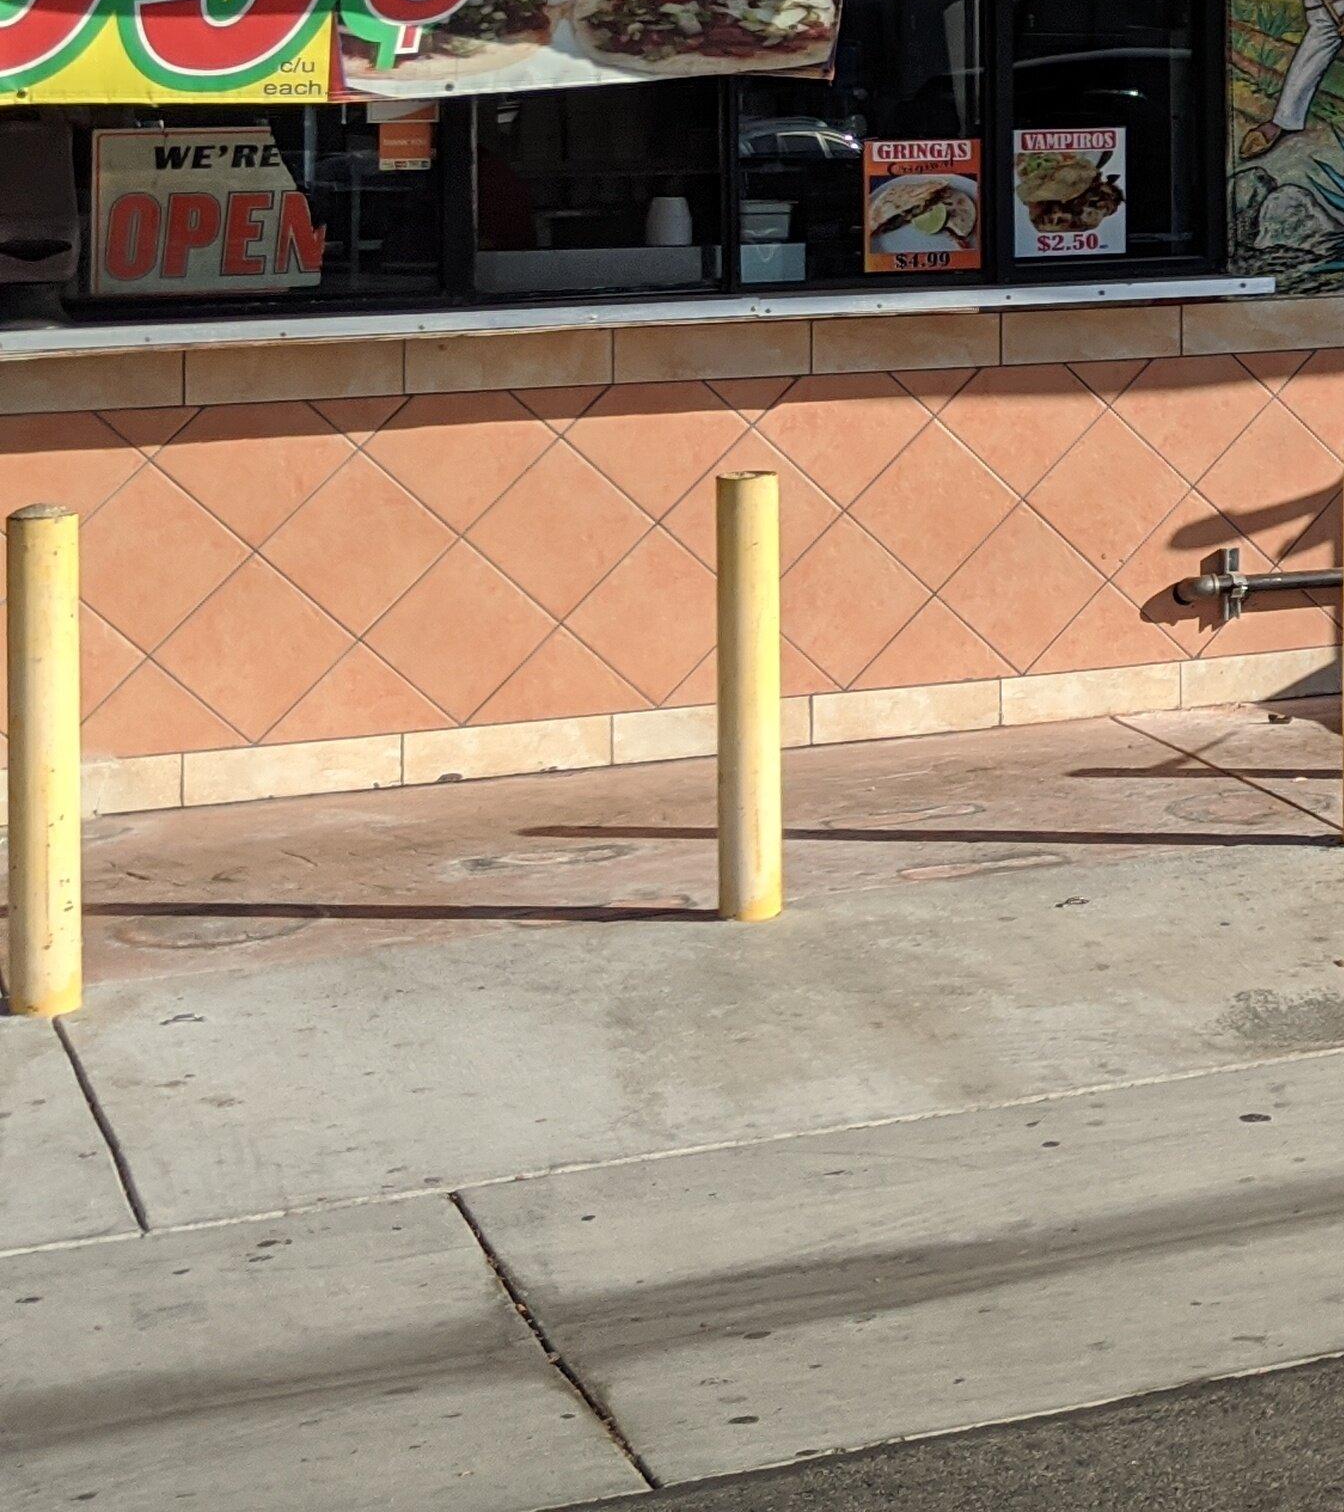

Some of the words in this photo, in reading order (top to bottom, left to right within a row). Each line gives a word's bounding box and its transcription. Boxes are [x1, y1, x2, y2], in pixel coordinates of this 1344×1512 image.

[280, 57, 316, 74] c/u
[877, 141, 968, 160] GRINGAS
[1023, 132, 1115, 150] VAMPIROS
[154, 144, 282, 169] WE'RE
[105, 189, 327, 282] OPEN
[1037, 233, 1099, 253] $2.50
[895, 251, 950, 269] $4.99
